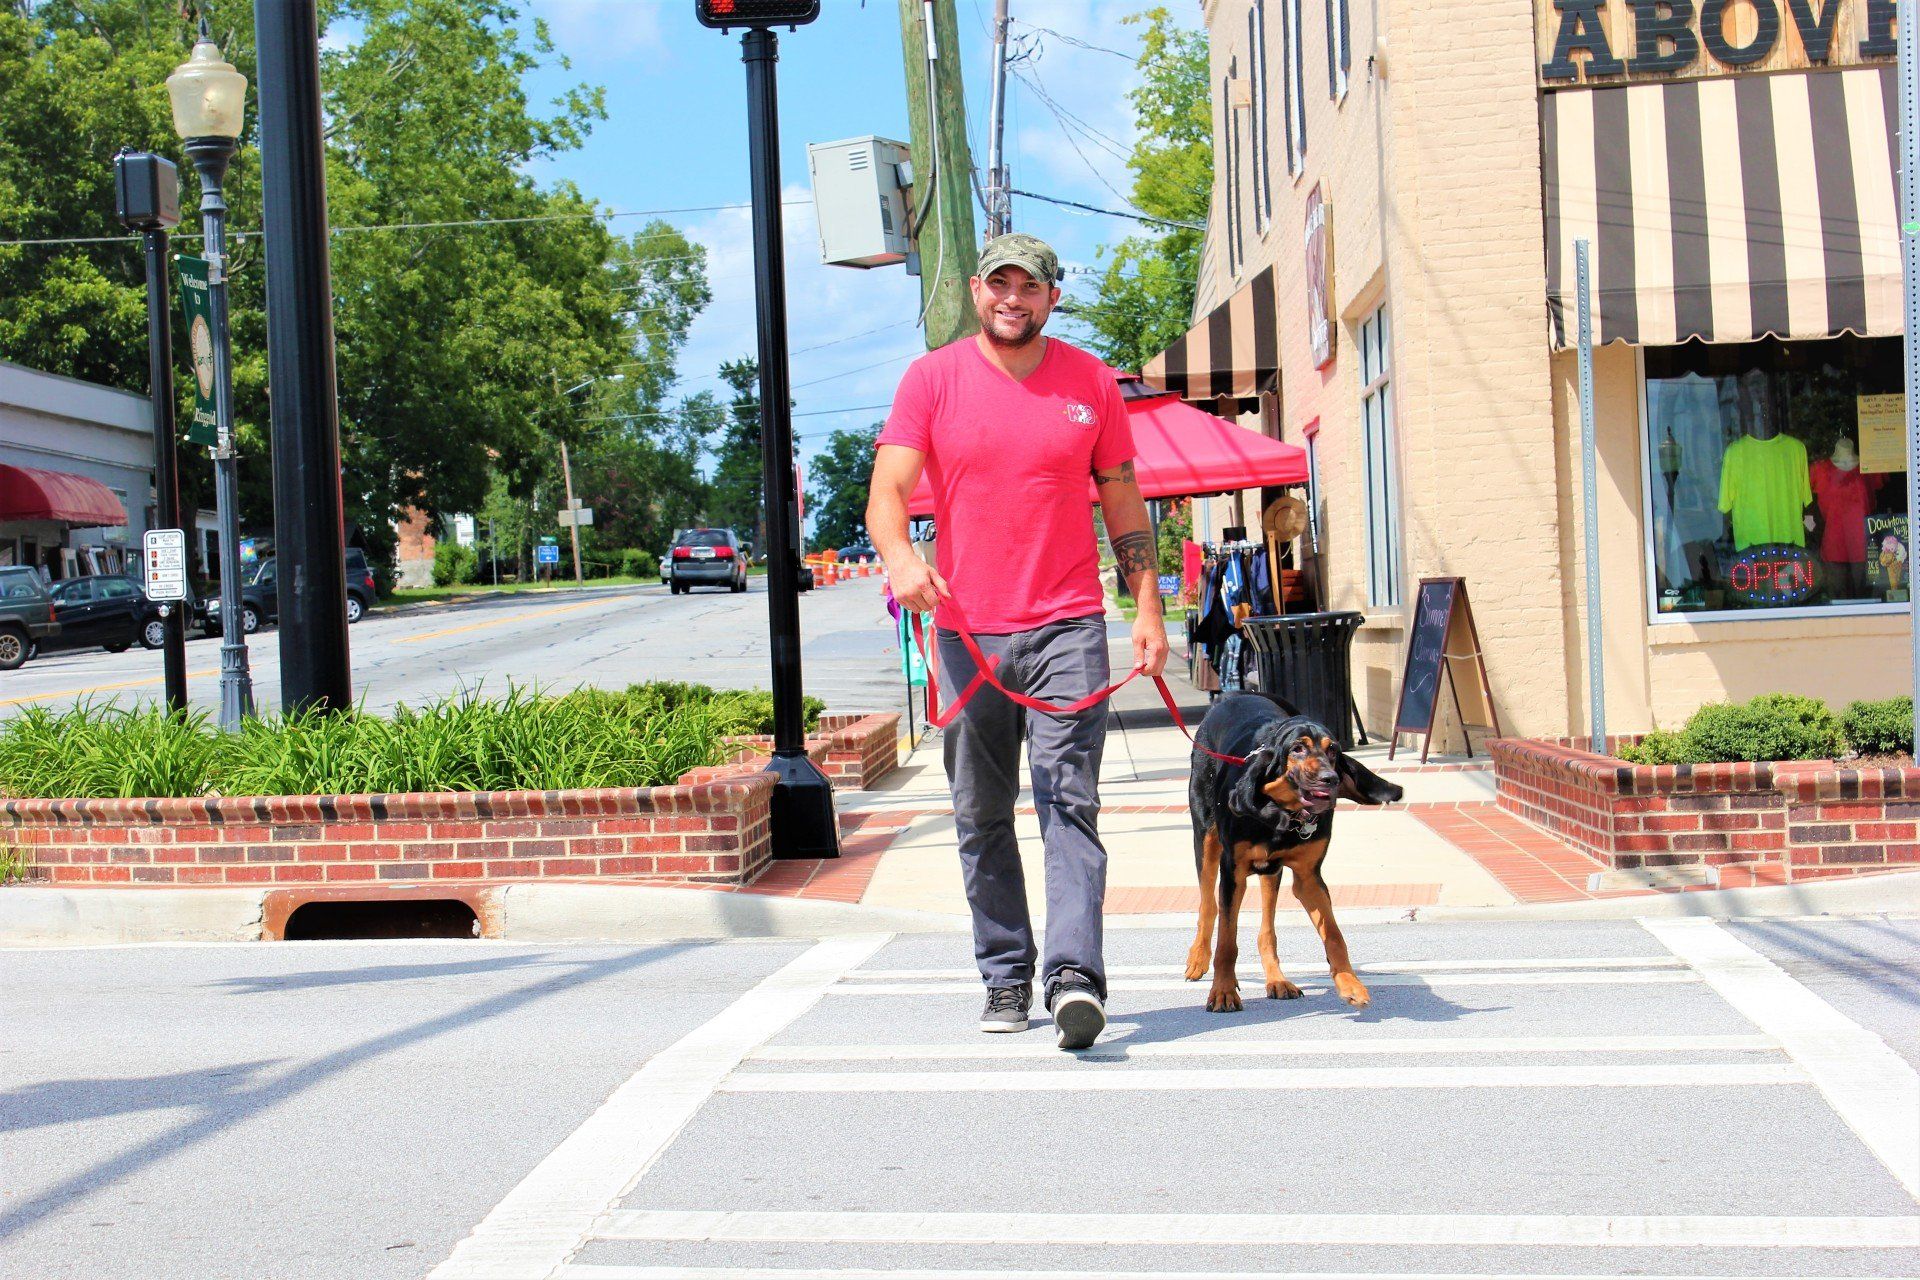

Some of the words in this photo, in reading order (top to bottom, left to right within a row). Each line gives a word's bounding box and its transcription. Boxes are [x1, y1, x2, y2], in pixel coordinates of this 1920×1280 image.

[181, 272, 208, 291] Welcome
[194, 292, 201, 305] to
[1867, 516, 1909, 534] Downtow
[1893, 526, 1909, 537] Nigh
[1731, 560, 1813, 591] OPEN
